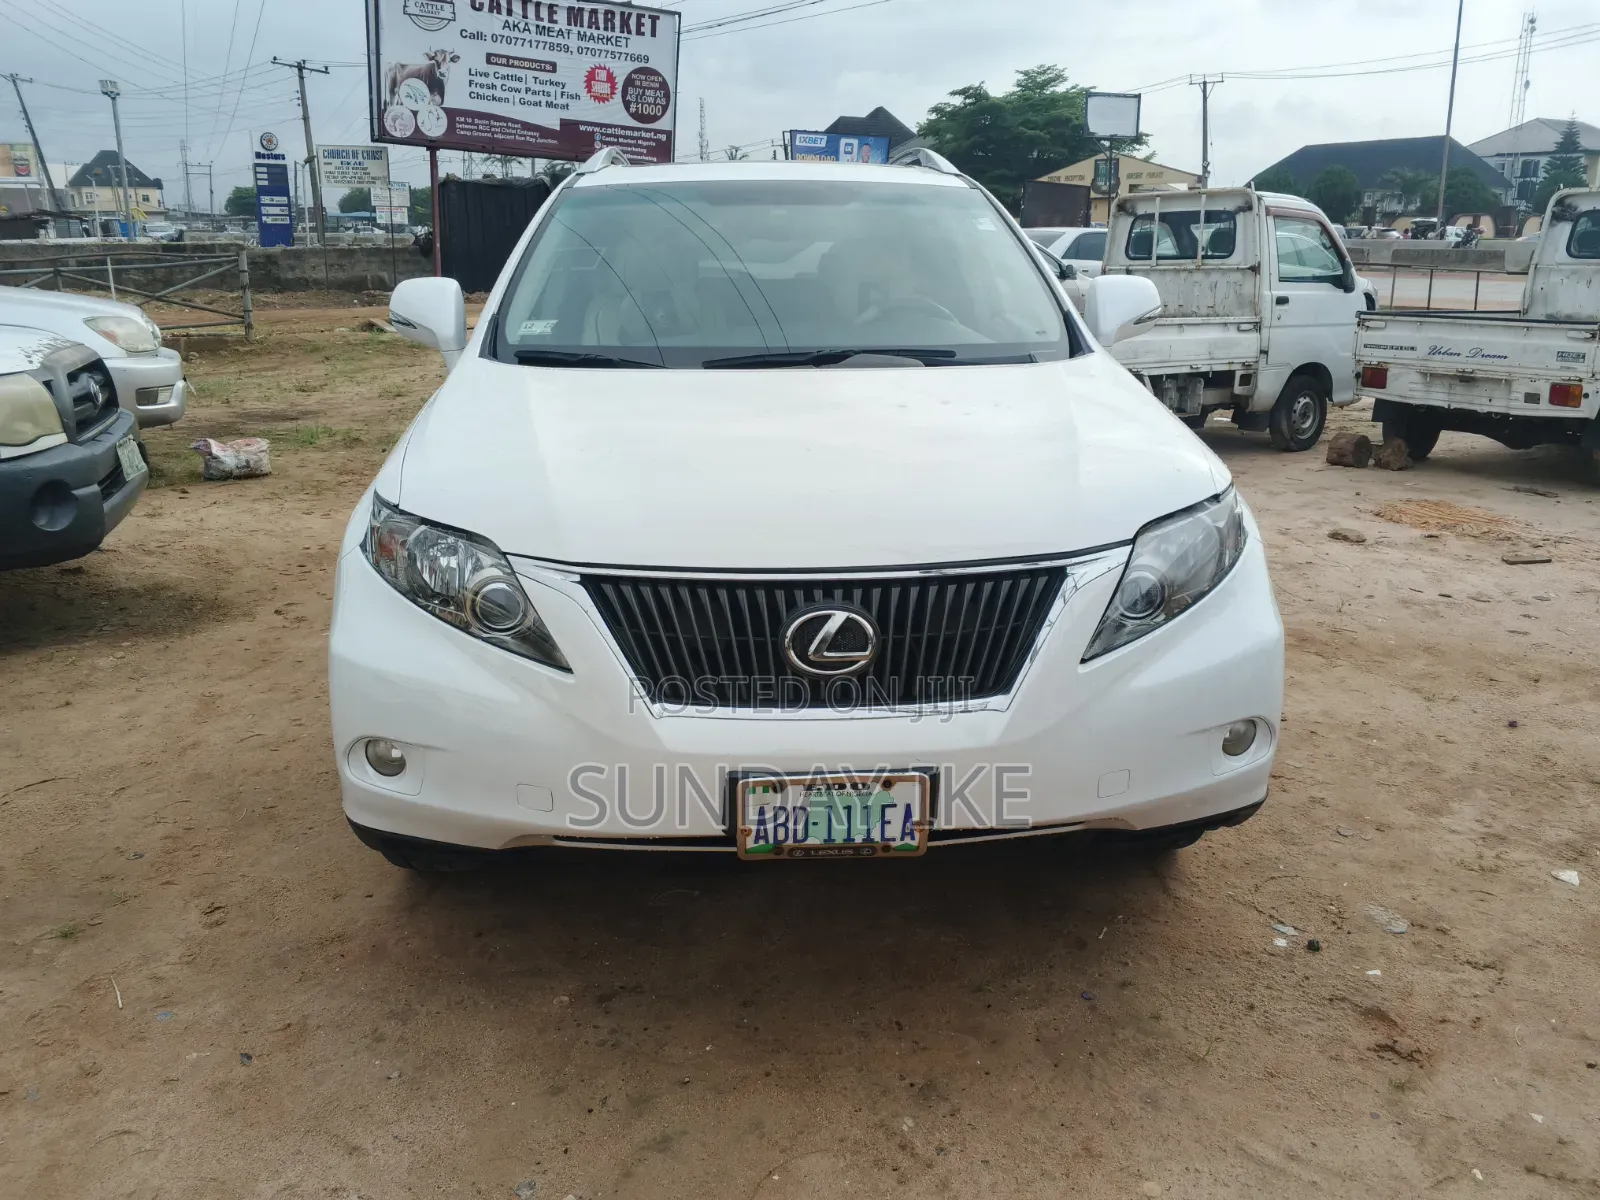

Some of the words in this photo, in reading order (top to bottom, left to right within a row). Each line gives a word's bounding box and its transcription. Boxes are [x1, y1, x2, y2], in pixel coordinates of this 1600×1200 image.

[414, 2, 445, 11] CATTLE
[566, 6, 660, 38] MARKET
[502, 20, 531, 34] AKA
[535, 24, 571, 40] MEAT
[577, 30, 631, 48] MARKET
[460, 29, 487, 41] Call:
[491, 33, 574, 55] 07077177859,
[577, 46, 650, 64] 07077577669
[490, 56, 508, 64] OUR
[509, 59, 552, 70] PRODUCTS:
[469, 68, 490, 78] Live
[493, 72, 524, 82] Cattle
[532, 76, 566, 90] Turkey
[469, 80, 497, 90] Fresh
[500, 84, 522, 94] Cow
[525, 86, 551, 98] Parts
[560, 91, 581, 100] Fish
[628, 87, 644, 95] BUY
[645, 89, 664, 98] MEAT
[469, 91, 510, 104] Chicken
[519, 97, 542, 108] Goat
[545, 100, 570, 110] Meat
[638, 96, 655, 104] LOW
[630, 102, 662, 116] #1000
[517, 129, 539, 137] Embassy
[579, 124, 666, 142] www.cattlemarket.ng
[799, 136, 824, 145] 1XBET
[322, 149, 350, 160] CHURCH
[352, 150, 360, 160] OF
[1428, 344, 1462, 357] Urban
[1465, 347, 1509, 360] Dream
[754, 802, 916, 844] ABD-111EA
